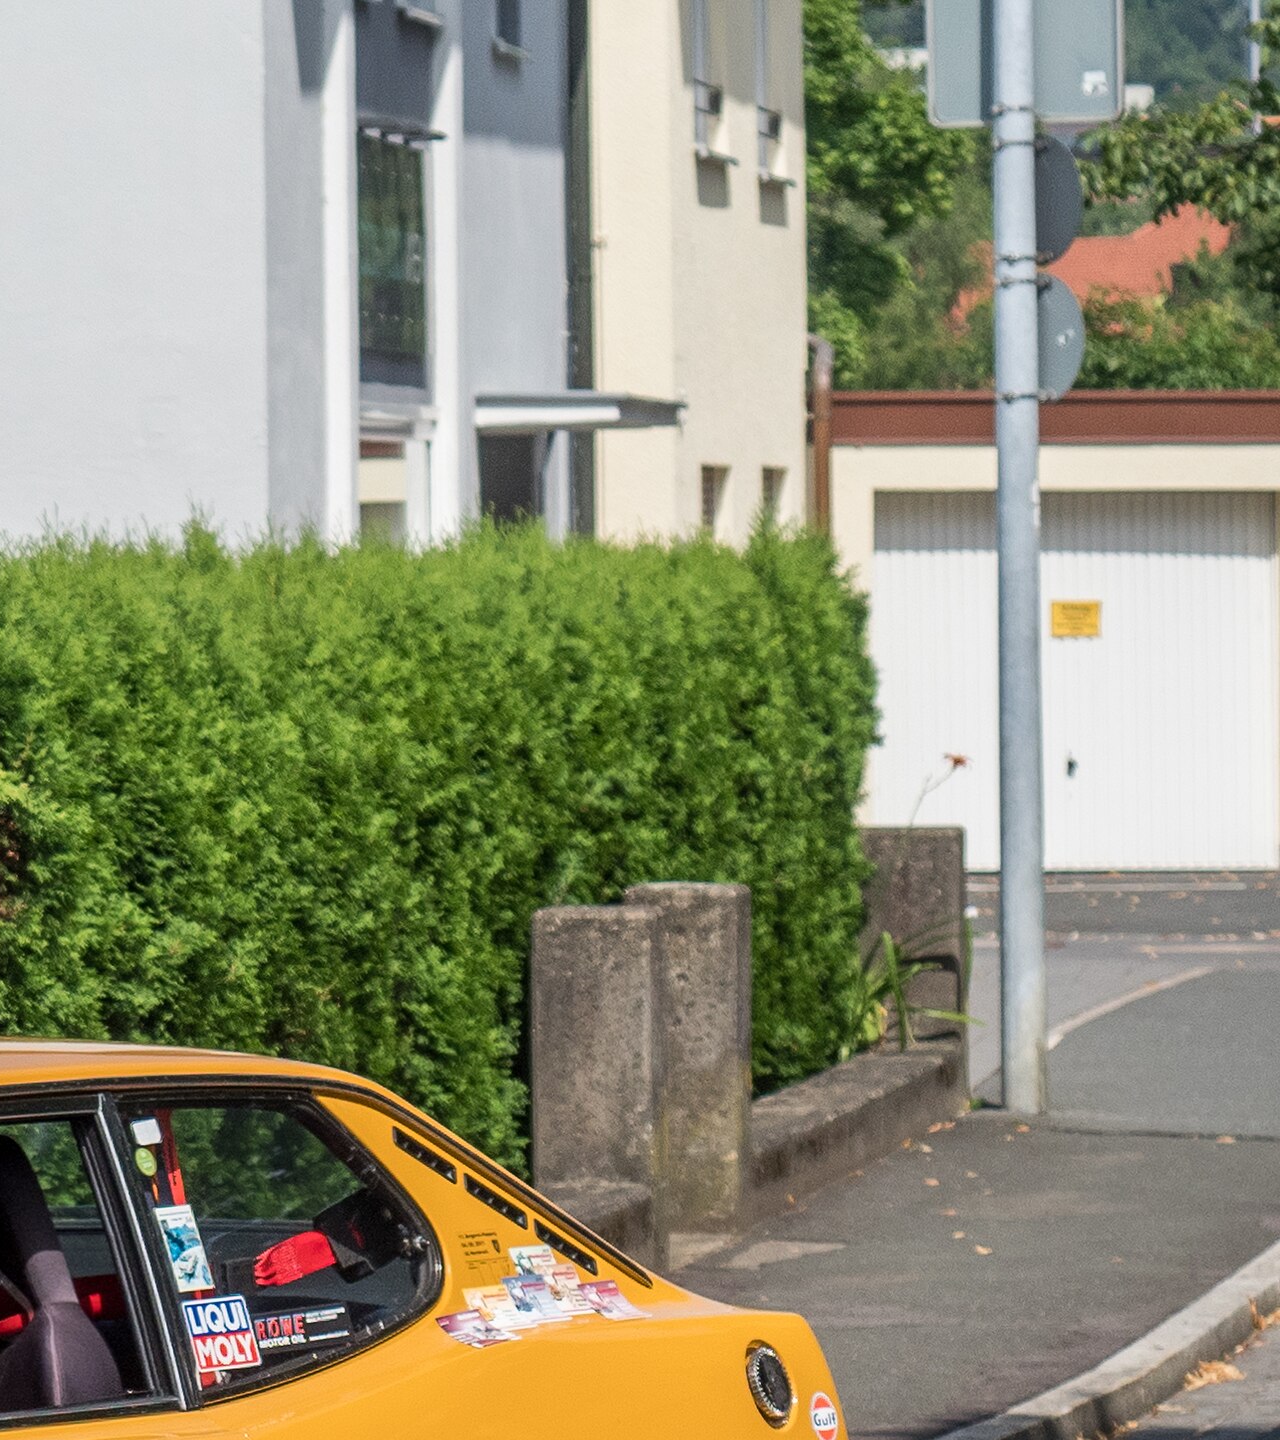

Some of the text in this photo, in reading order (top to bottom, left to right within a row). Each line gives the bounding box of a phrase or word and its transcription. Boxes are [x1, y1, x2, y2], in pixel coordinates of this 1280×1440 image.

[186, 1301, 248, 1335] LIQUI
[254, 1313, 306, 1340] ROWE
[194, 1335, 255, 1367] MOLY
[259, 1335, 290, 1349] MOTOR
[291, 1333, 307, 1345] OIL
[813, 1412, 836, 1427] Gulf
